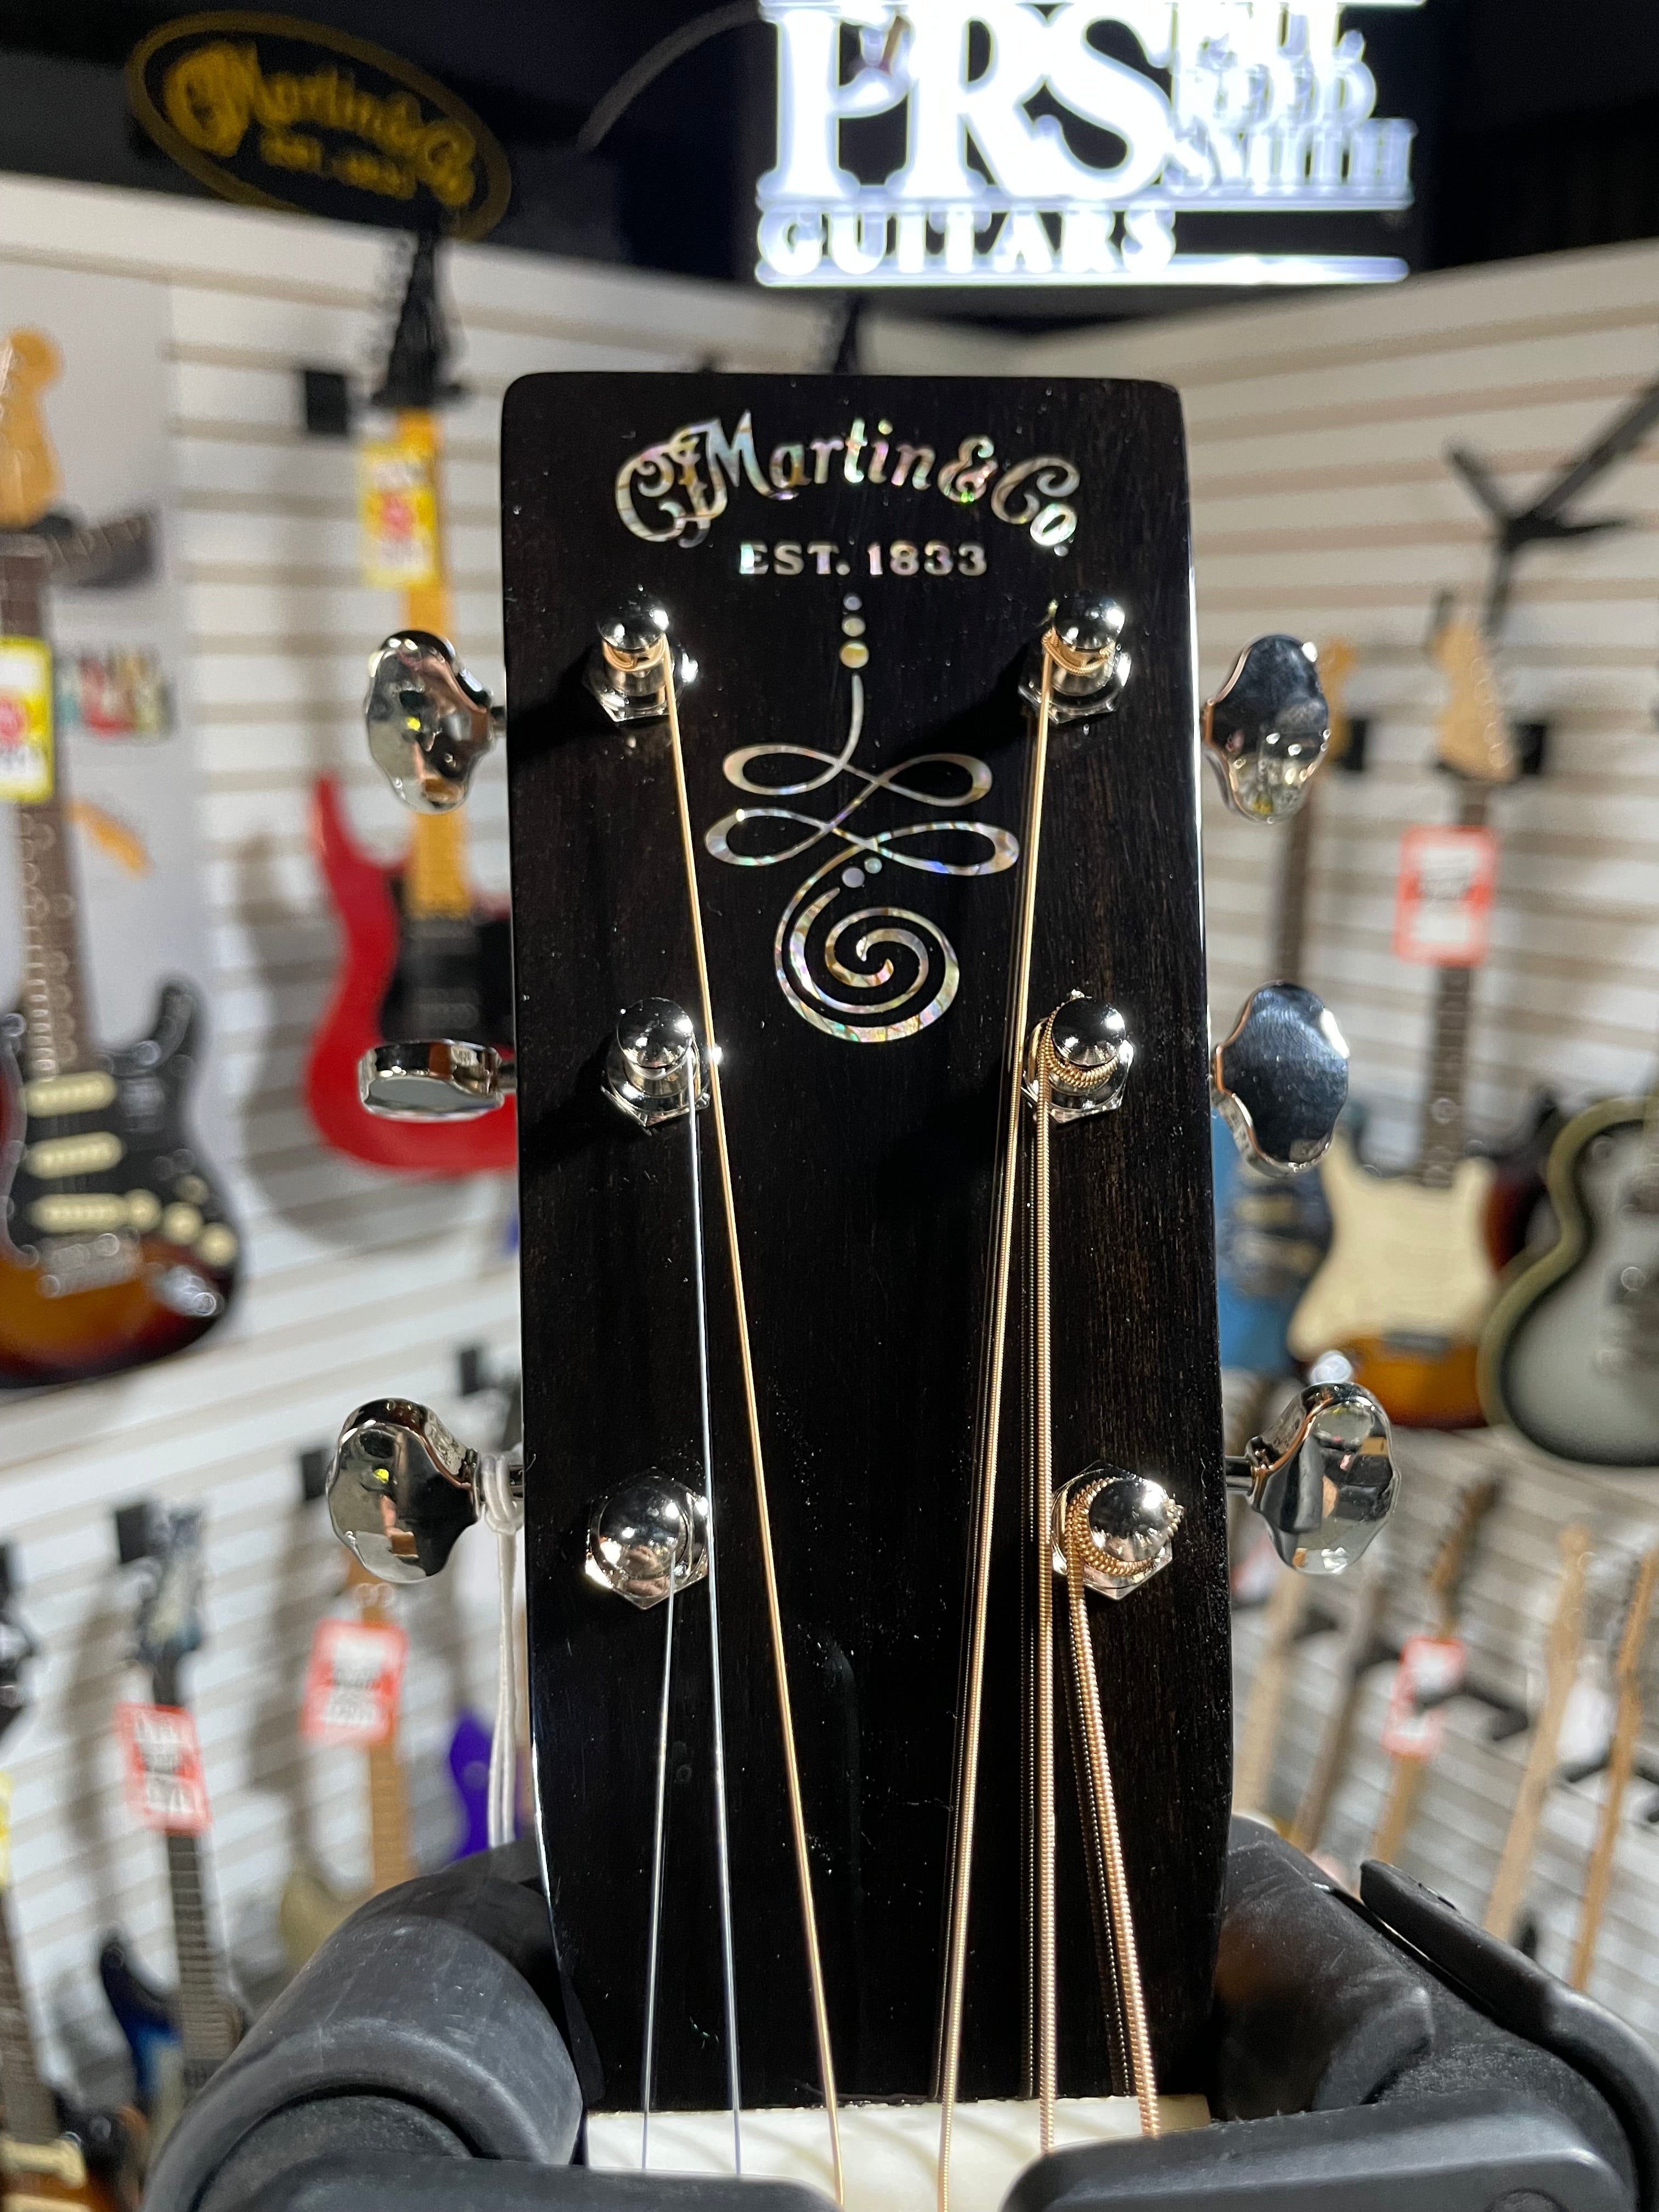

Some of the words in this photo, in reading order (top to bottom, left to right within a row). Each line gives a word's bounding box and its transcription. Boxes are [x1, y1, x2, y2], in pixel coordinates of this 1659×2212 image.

[758, 3, 1175, 200] PRS
[757, 203, 1177, 275] GUITARS
[689, 410, 936, 516] Martin
[738, 540, 851, 575] EST.
[868, 539, 987, 576] 1833
